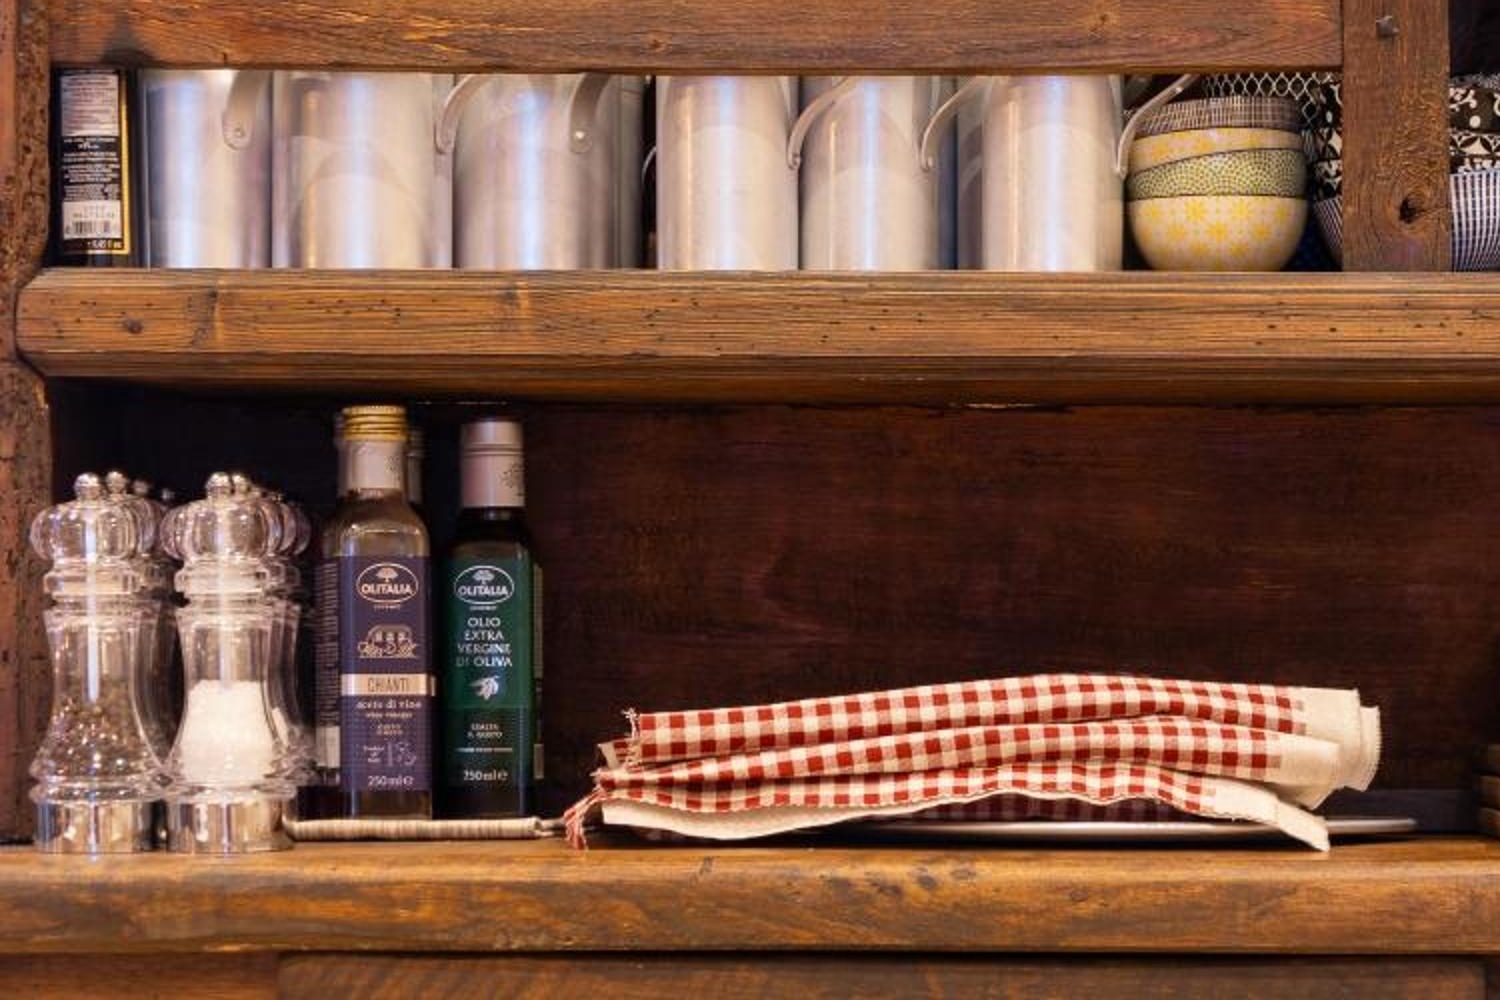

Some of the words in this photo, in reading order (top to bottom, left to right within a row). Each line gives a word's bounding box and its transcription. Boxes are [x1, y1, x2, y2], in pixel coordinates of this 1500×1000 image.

[361, 583, 412, 595] OLITALIA
[457, 585, 508, 596] OLITALIA
[467, 617, 501, 628] OLIO
[464, 629, 504, 641] EXTRA
[457, 642, 511, 654] VERGINE
[456, 656, 469, 667] DI
[473, 655, 513, 667] OLIVA
[367, 677, 410, 693] CHIANTI
[385, 698, 397, 709] di
